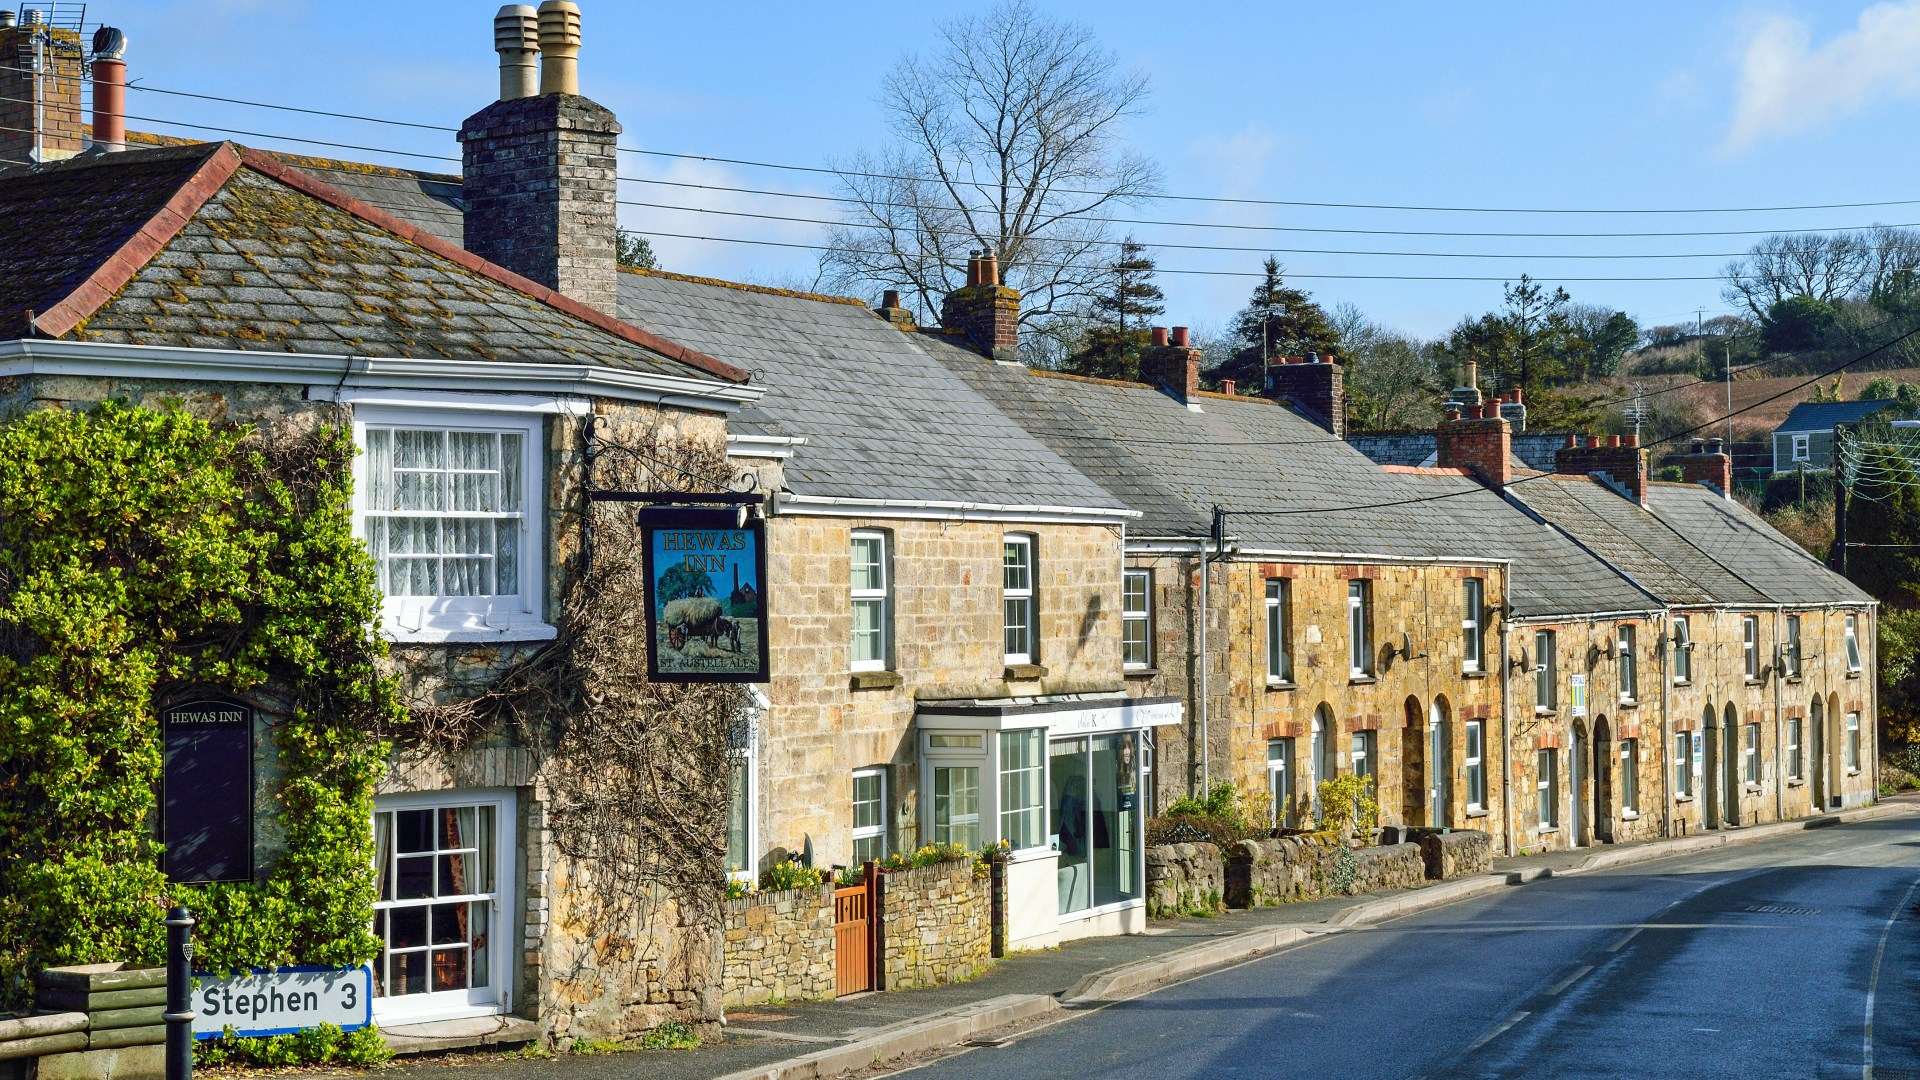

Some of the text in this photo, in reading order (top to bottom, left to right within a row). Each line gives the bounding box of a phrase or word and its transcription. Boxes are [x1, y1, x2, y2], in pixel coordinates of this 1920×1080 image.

[663, 531, 746, 551] HEWAS
[683, 554, 726, 573] INN
[679, 658, 726, 668] AUSTELL
[729, 658, 758, 668] ALES
[170, 711, 243, 724] HEWAS INN
[202, 982, 358, 1021] Stephen 3
